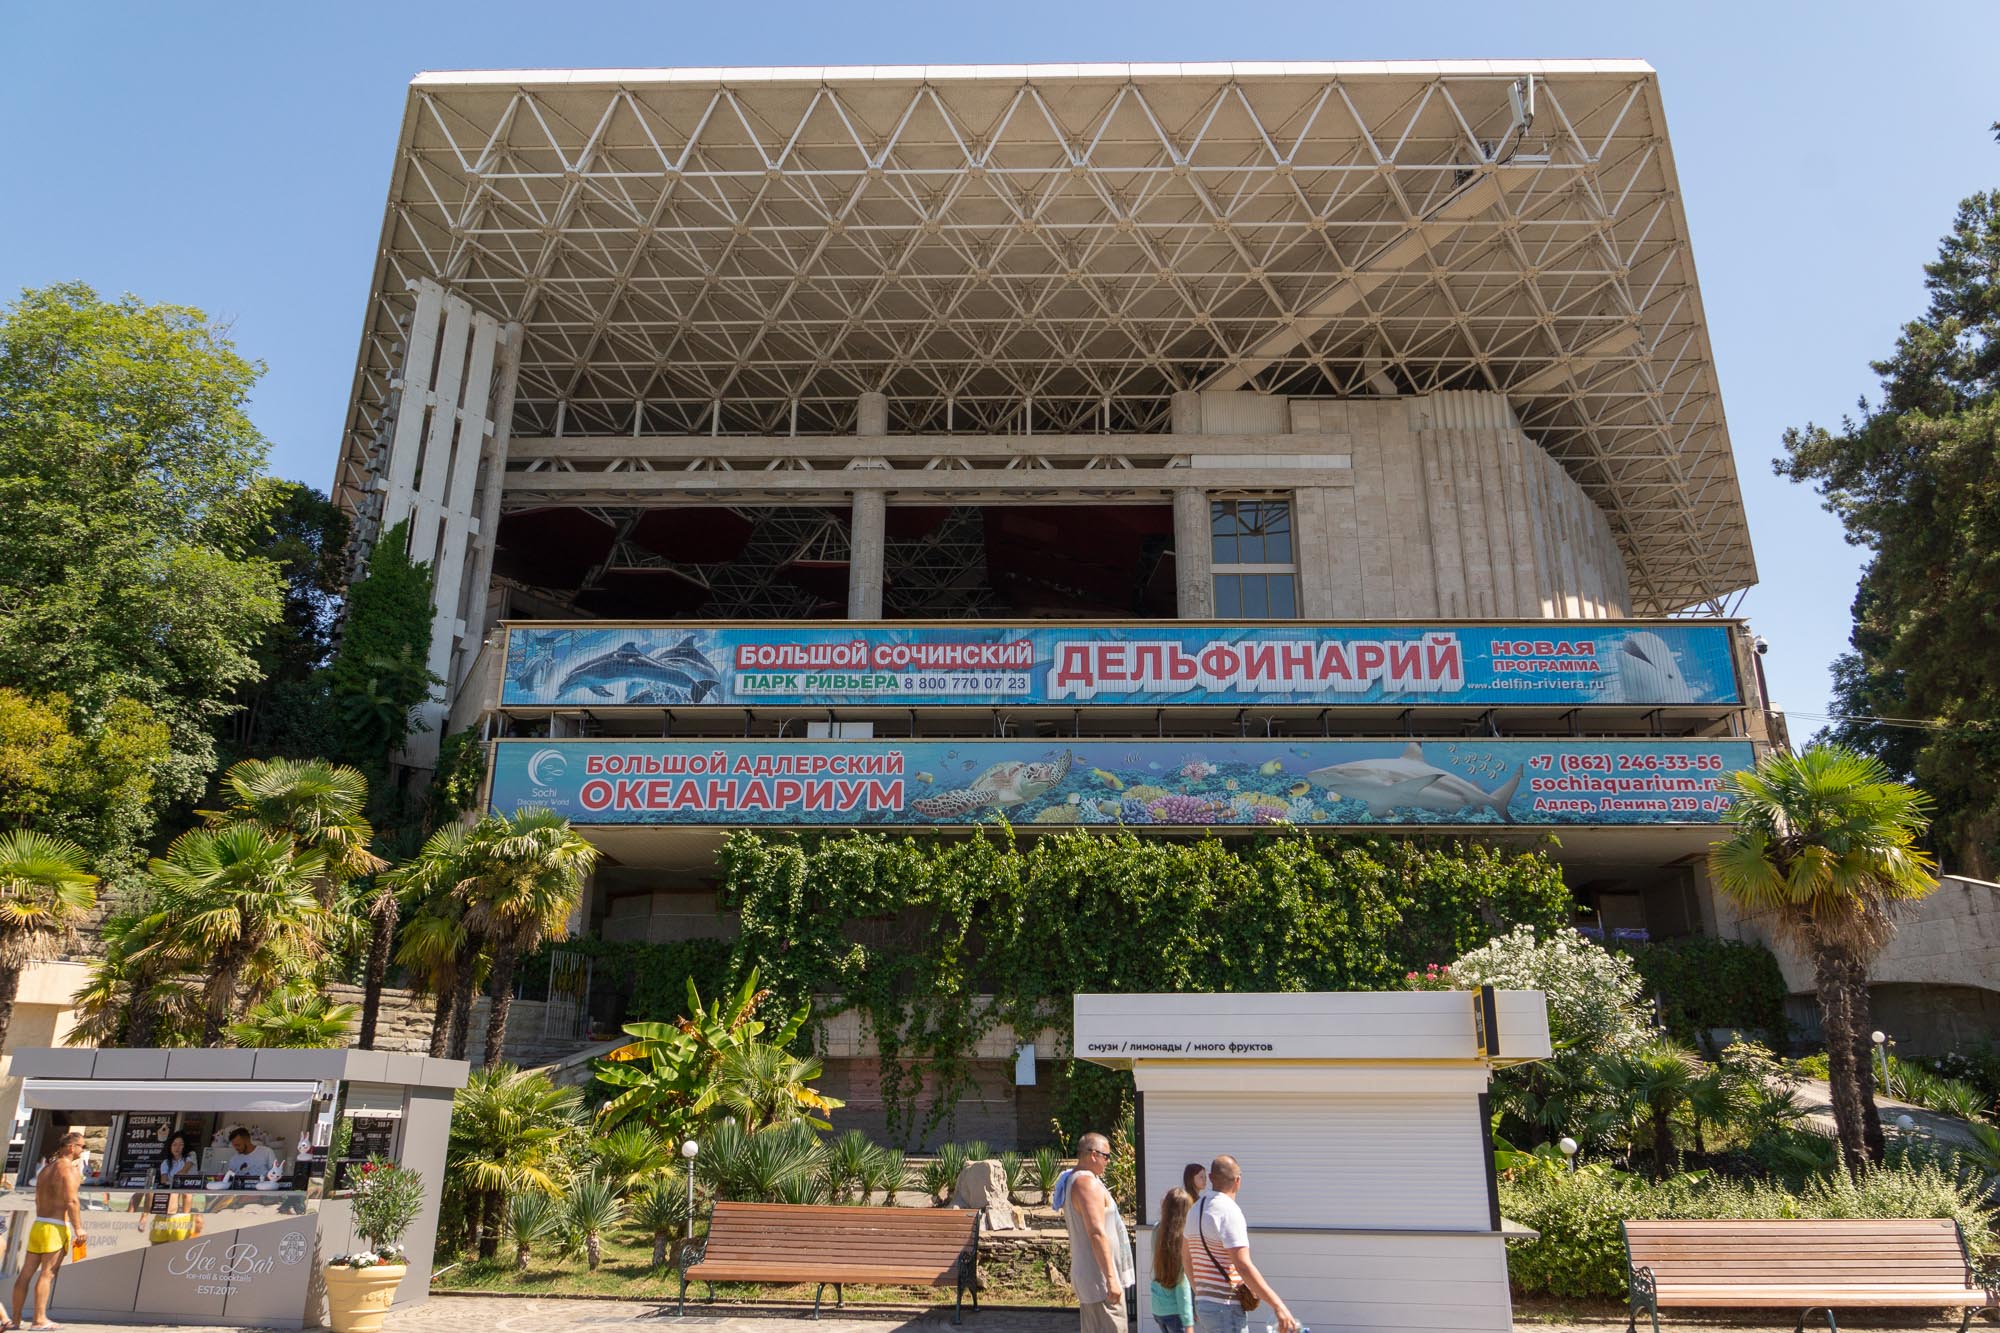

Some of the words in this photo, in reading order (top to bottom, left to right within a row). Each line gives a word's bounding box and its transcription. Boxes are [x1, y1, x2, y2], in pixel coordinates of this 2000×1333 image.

[738, 640, 868, 666] БОЛЬШОЙ
[873, 640, 1033, 666] СОЧИНСКИЙ
[1492, 641, 1595, 656] НОВАЯ
[1056, 635, 1462, 688] ДЕЛЬФИНАРИЙ
[1493, 660, 1600, 672] ПРОГРАММА
[743, 675, 798, 690] ПАРК
[805, 675, 899, 690] РИВЬЕРА
[904, 677, 914, 689] 8
[918, 677, 946, 689] 800
[952, 677, 979, 689] 770
[985, 677, 1002, 689] 07
[1008, 677, 1026, 689] 23
[1467, 678, 1604, 689] www.delfin-riviera.ru
[586, 751, 728, 775] БОЛЬШОЙ
[733, 751, 905, 777] АДЛЕРСКИЙ
[1530, 755, 1553, 770] +7
[1560, 754, 1612, 773] (862)
[1618, 755, 1722, 771] 246-33-56
[1531, 775, 1726, 794] sochiaquarium.ru
[531, 788, 557, 797] Sochi
[580, 779, 905, 811] ОКЕАНАРИУМ
[1534, 798, 1596, 812] Адлер,
[1601, 798, 1667, 811] Ленина
[1671, 798, 1697, 811] 219
[1703, 797, 1730, 812] а/4
[1088, 1043, 1119, 1052] смузи
[1130, 1043, 1182, 1053] лимонады
[1194, 1043, 1226, 1052] много
[1228, 1042, 1273, 1053] фруктов
[168, 1239, 216, 1275] Ice
[220, 1243, 274, 1274] Bar
[186, 1273, 211, 1281] ice-roll
[212, 1273, 218, 1281] &
[220, 1274, 252, 1282] cocktails
